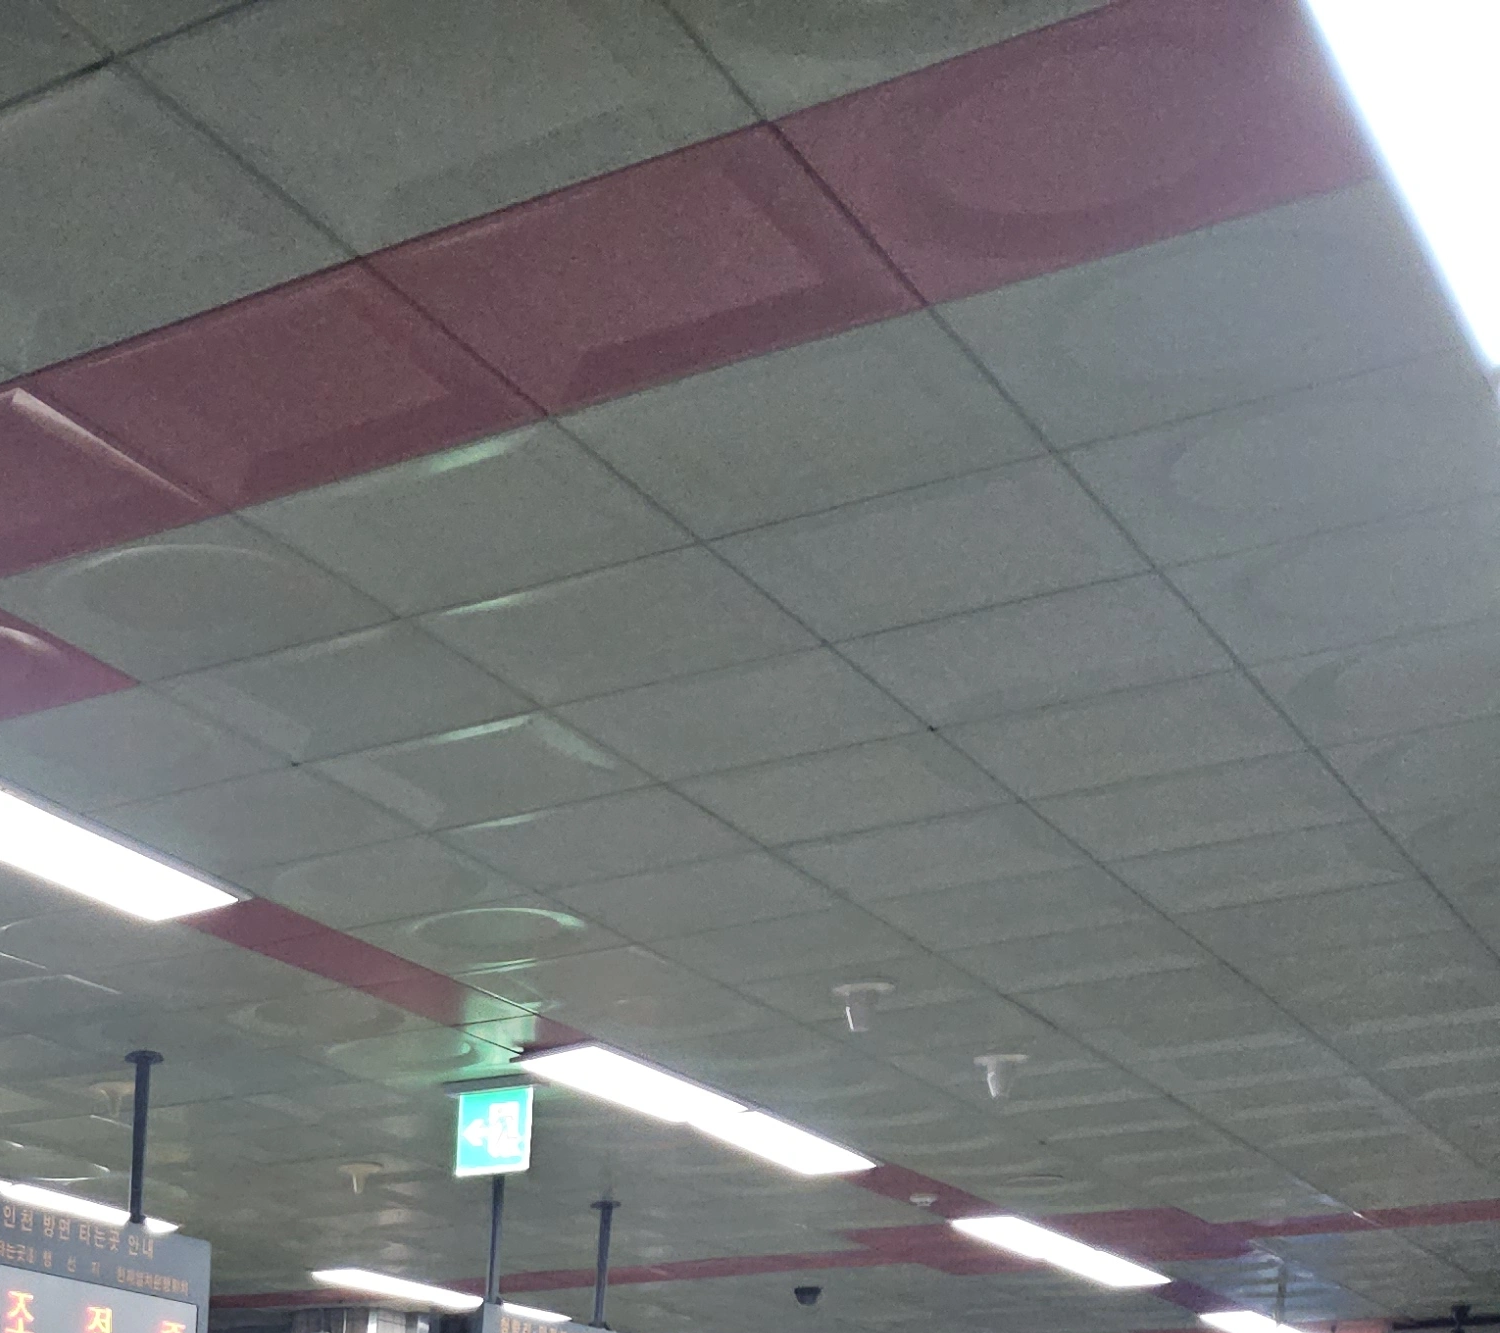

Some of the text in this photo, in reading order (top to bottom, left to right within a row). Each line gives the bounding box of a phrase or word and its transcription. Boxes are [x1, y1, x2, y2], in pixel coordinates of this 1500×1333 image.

[3, 1205, 35, 1233] 인천
[79, 1221, 121, 1253] 타는곳
[128, 1234, 155, 1260] 안내
